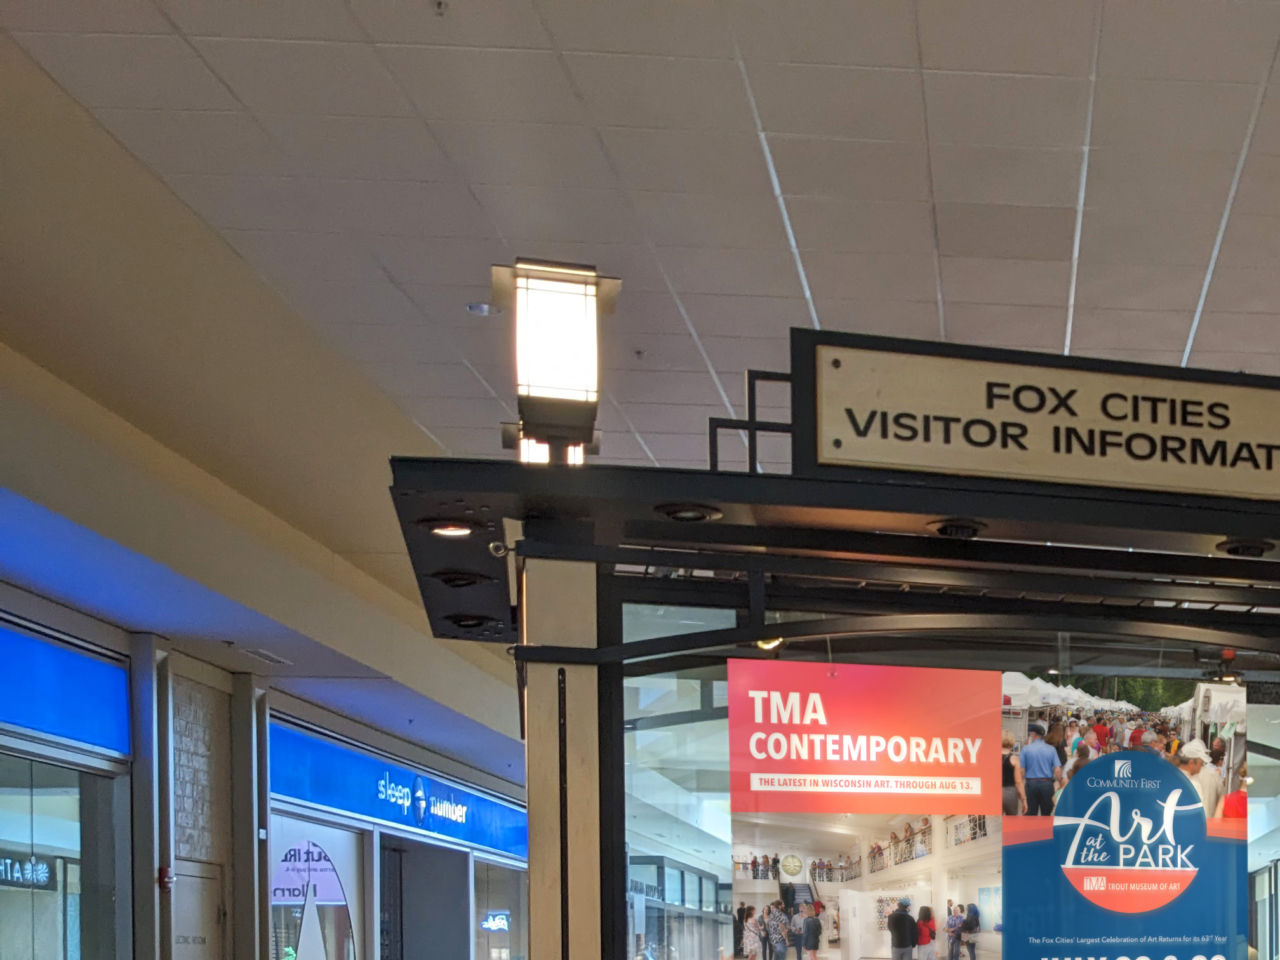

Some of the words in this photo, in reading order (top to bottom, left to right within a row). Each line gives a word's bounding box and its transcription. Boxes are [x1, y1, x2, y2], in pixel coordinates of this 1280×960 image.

[986, 381, 1079, 417] FOX
[1100, 392, 1232, 430] CITIES
[845, 407, 1029, 451] VISITOR
[748, 690, 828, 726] TMA
[749, 732, 983, 764] CONTEMPORARY
[377, 771, 412, 816] sleep
[429, 793, 468, 824] number
[758, 777, 775, 787] THE
[777, 778, 807, 788] LATEST
[809, 778, 819, 788] IN
[821, 779, 872, 789] WISCONSIN
[874, 780, 893, 789] ART.
[894, 780, 937, 790] THROUGH
[939, 781, 957, 790] AUG
[959, 781, 974, 790] 13.
[1053, 788, 1204, 867] Art
[1086, 833, 1106, 849] at
[1080, 847, 1110, 864] the
[1119, 844, 1195, 869] PARK
[1028, 936, 1041, 944] The
[1042, 936, 1054, 944] Fox
[1077, 936, 1100, 945] Largest
[1102, 935, 1139, 943] Celebration
[1148, 935, 1158, 943] Art
[1183, 934, 1191, 942] for
[1214, 934, 1227, 942] Year
